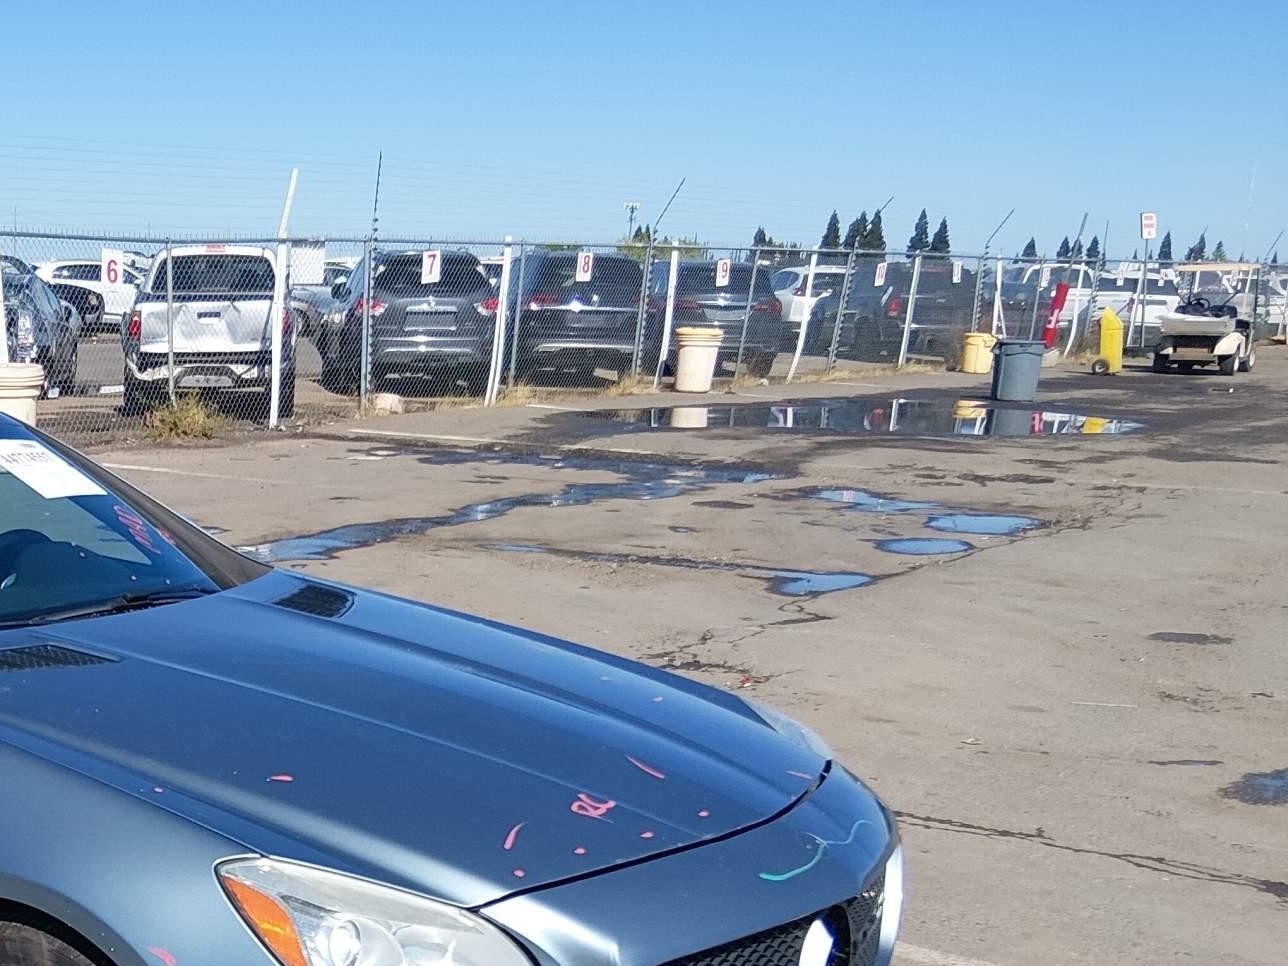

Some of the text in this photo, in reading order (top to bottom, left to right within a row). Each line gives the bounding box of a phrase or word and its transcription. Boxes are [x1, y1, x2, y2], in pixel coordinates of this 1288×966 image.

[106, 259, 119, 284] 6
[427, 254, 437, 275] 7
[582, 254, 591, 274] 8
[721, 261, 729, 279] 9
